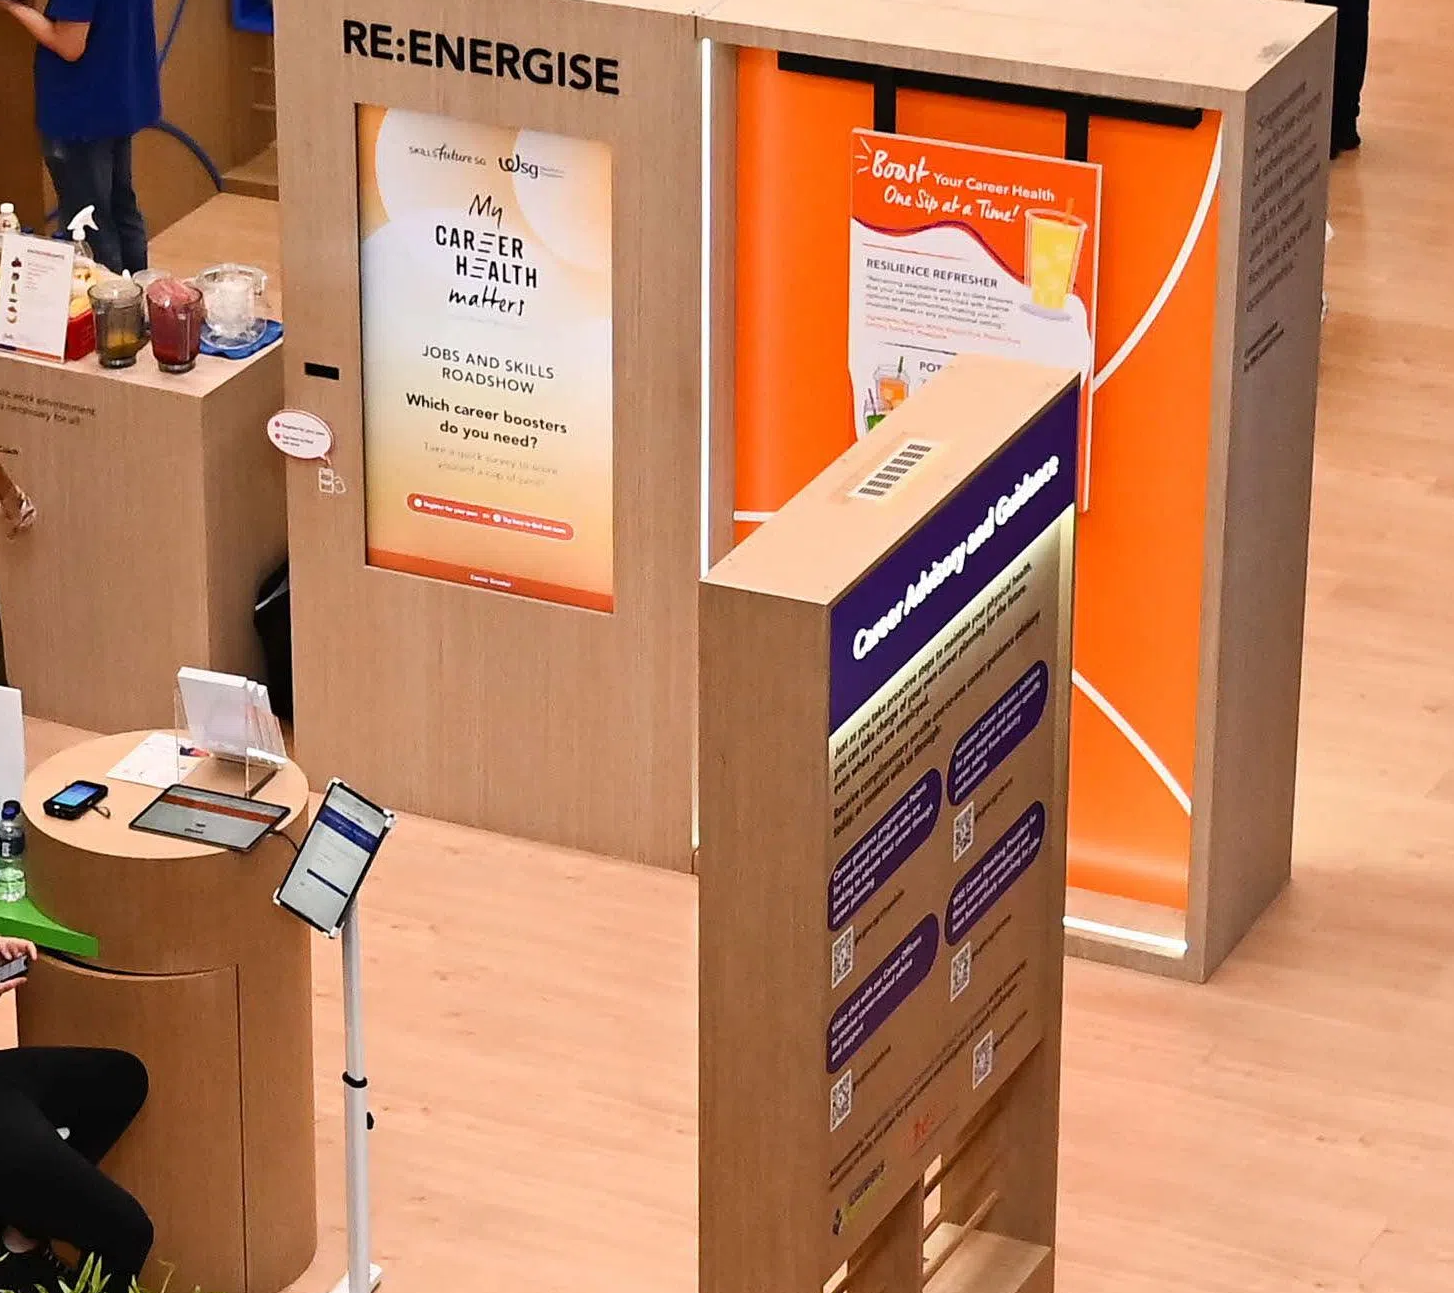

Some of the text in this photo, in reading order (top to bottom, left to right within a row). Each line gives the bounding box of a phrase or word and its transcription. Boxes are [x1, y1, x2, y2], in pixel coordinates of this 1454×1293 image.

[342, 18, 621, 96] RE:ENERGISE
[872, 149, 1055, 202] Boost Your Career Health
[469, 194, 503, 229] My
[883, 185, 1020, 223] One Sip at a Time!
[435, 225, 523, 259] CAREER
[456, 255, 537, 288] HEALTH
[866, 258, 998, 288] RESILIENCE REFRESHER
[449, 286, 525, 316] matters
[422, 344, 554, 379] JOBS AND SKILLS
[442, 367, 535, 395] ROADSHOW
[406, 393, 567, 434] Which career boosters
[440, 421, 538, 449] do you need?
[852, 454, 1061, 661] Career Advisory and Guidance
